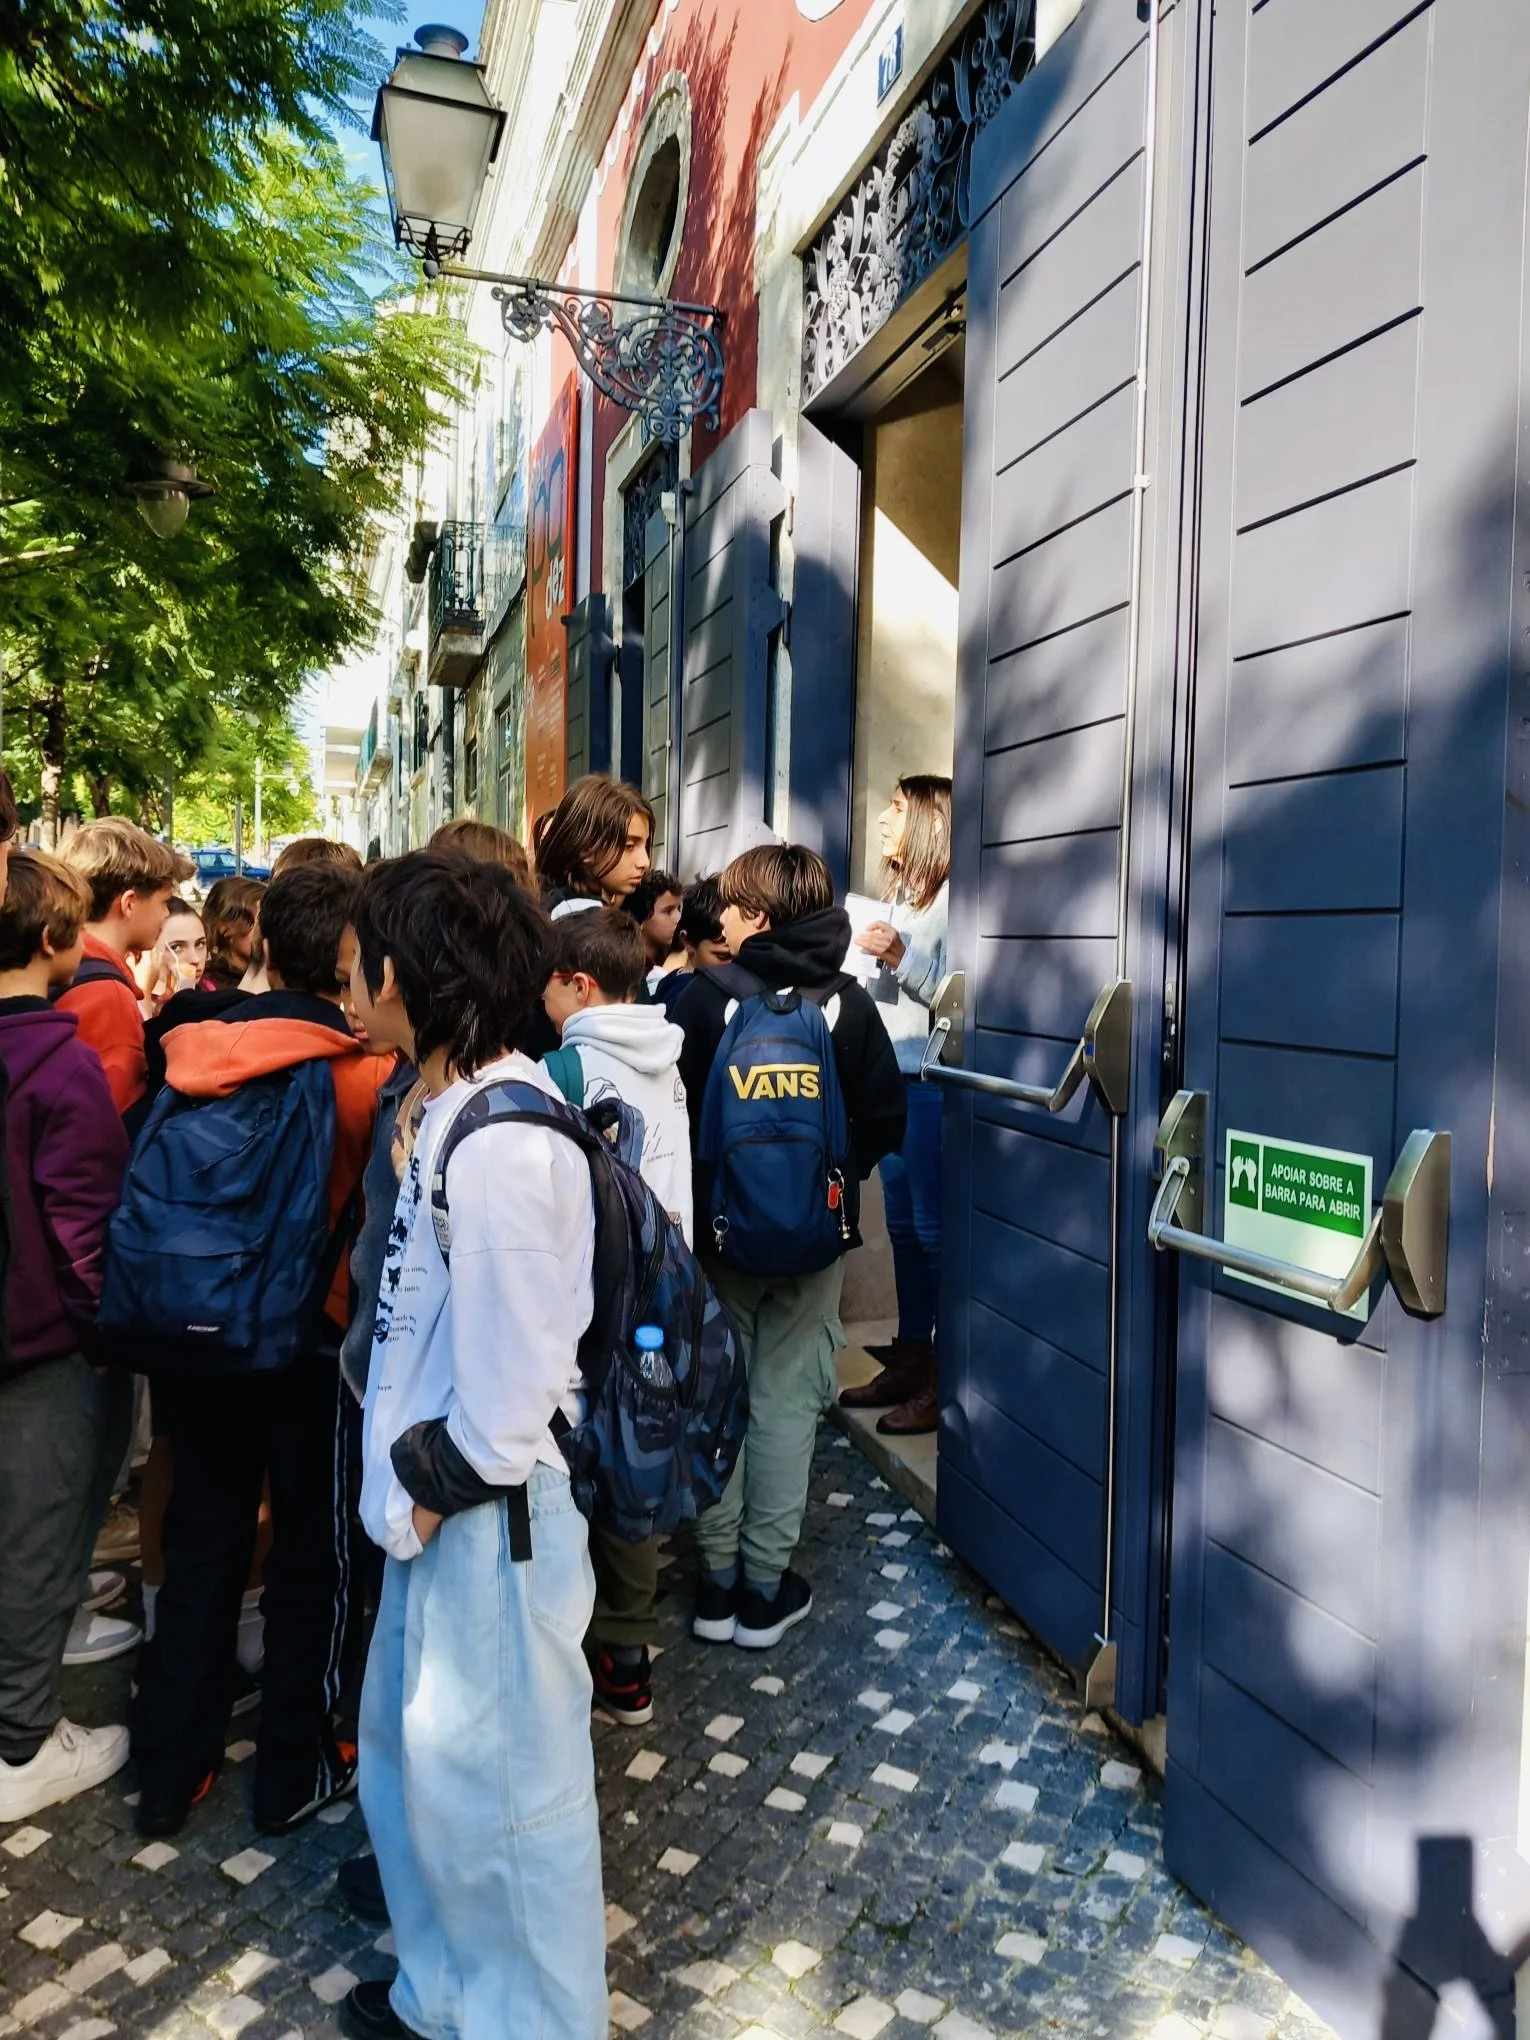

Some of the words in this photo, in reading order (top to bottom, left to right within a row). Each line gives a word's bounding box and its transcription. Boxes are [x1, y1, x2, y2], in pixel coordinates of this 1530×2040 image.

[545, 555, 566, 620] dez
[728, 1063, 820, 1100] VANS
[1271, 1163, 1306, 1184] APOIAR
[1309, 1171, 1343, 1193] SOBRE
[1346, 1180, 1354, 1196] A
[1265, 1183, 1297, 1205] BARRA
[1300, 1193, 1326, 1213] PARA
[1329, 1199, 1361, 1221] ABRIR
